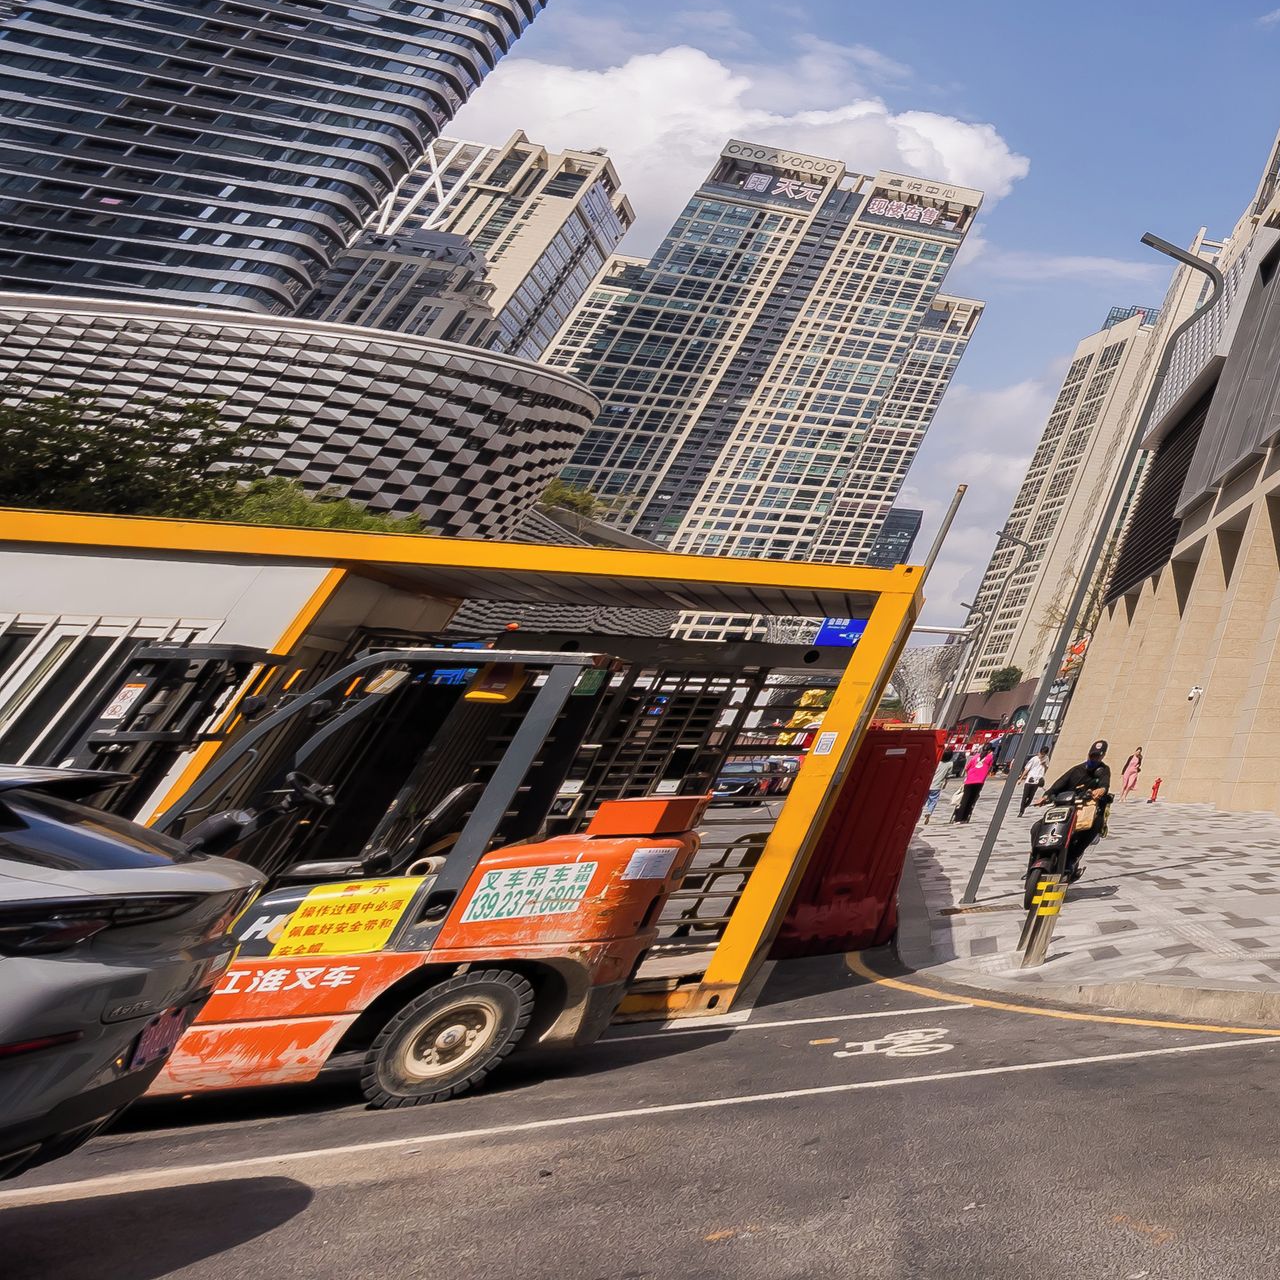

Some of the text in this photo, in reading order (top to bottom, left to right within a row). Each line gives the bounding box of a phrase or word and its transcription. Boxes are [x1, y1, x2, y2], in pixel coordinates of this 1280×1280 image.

[867, 198, 940, 225] 现楼在售
[299, 898, 405, 920] 操作过程中必须
[287, 918, 394, 939] 佩戴好安全带和
[277, 942, 325, 957] 安全帽
